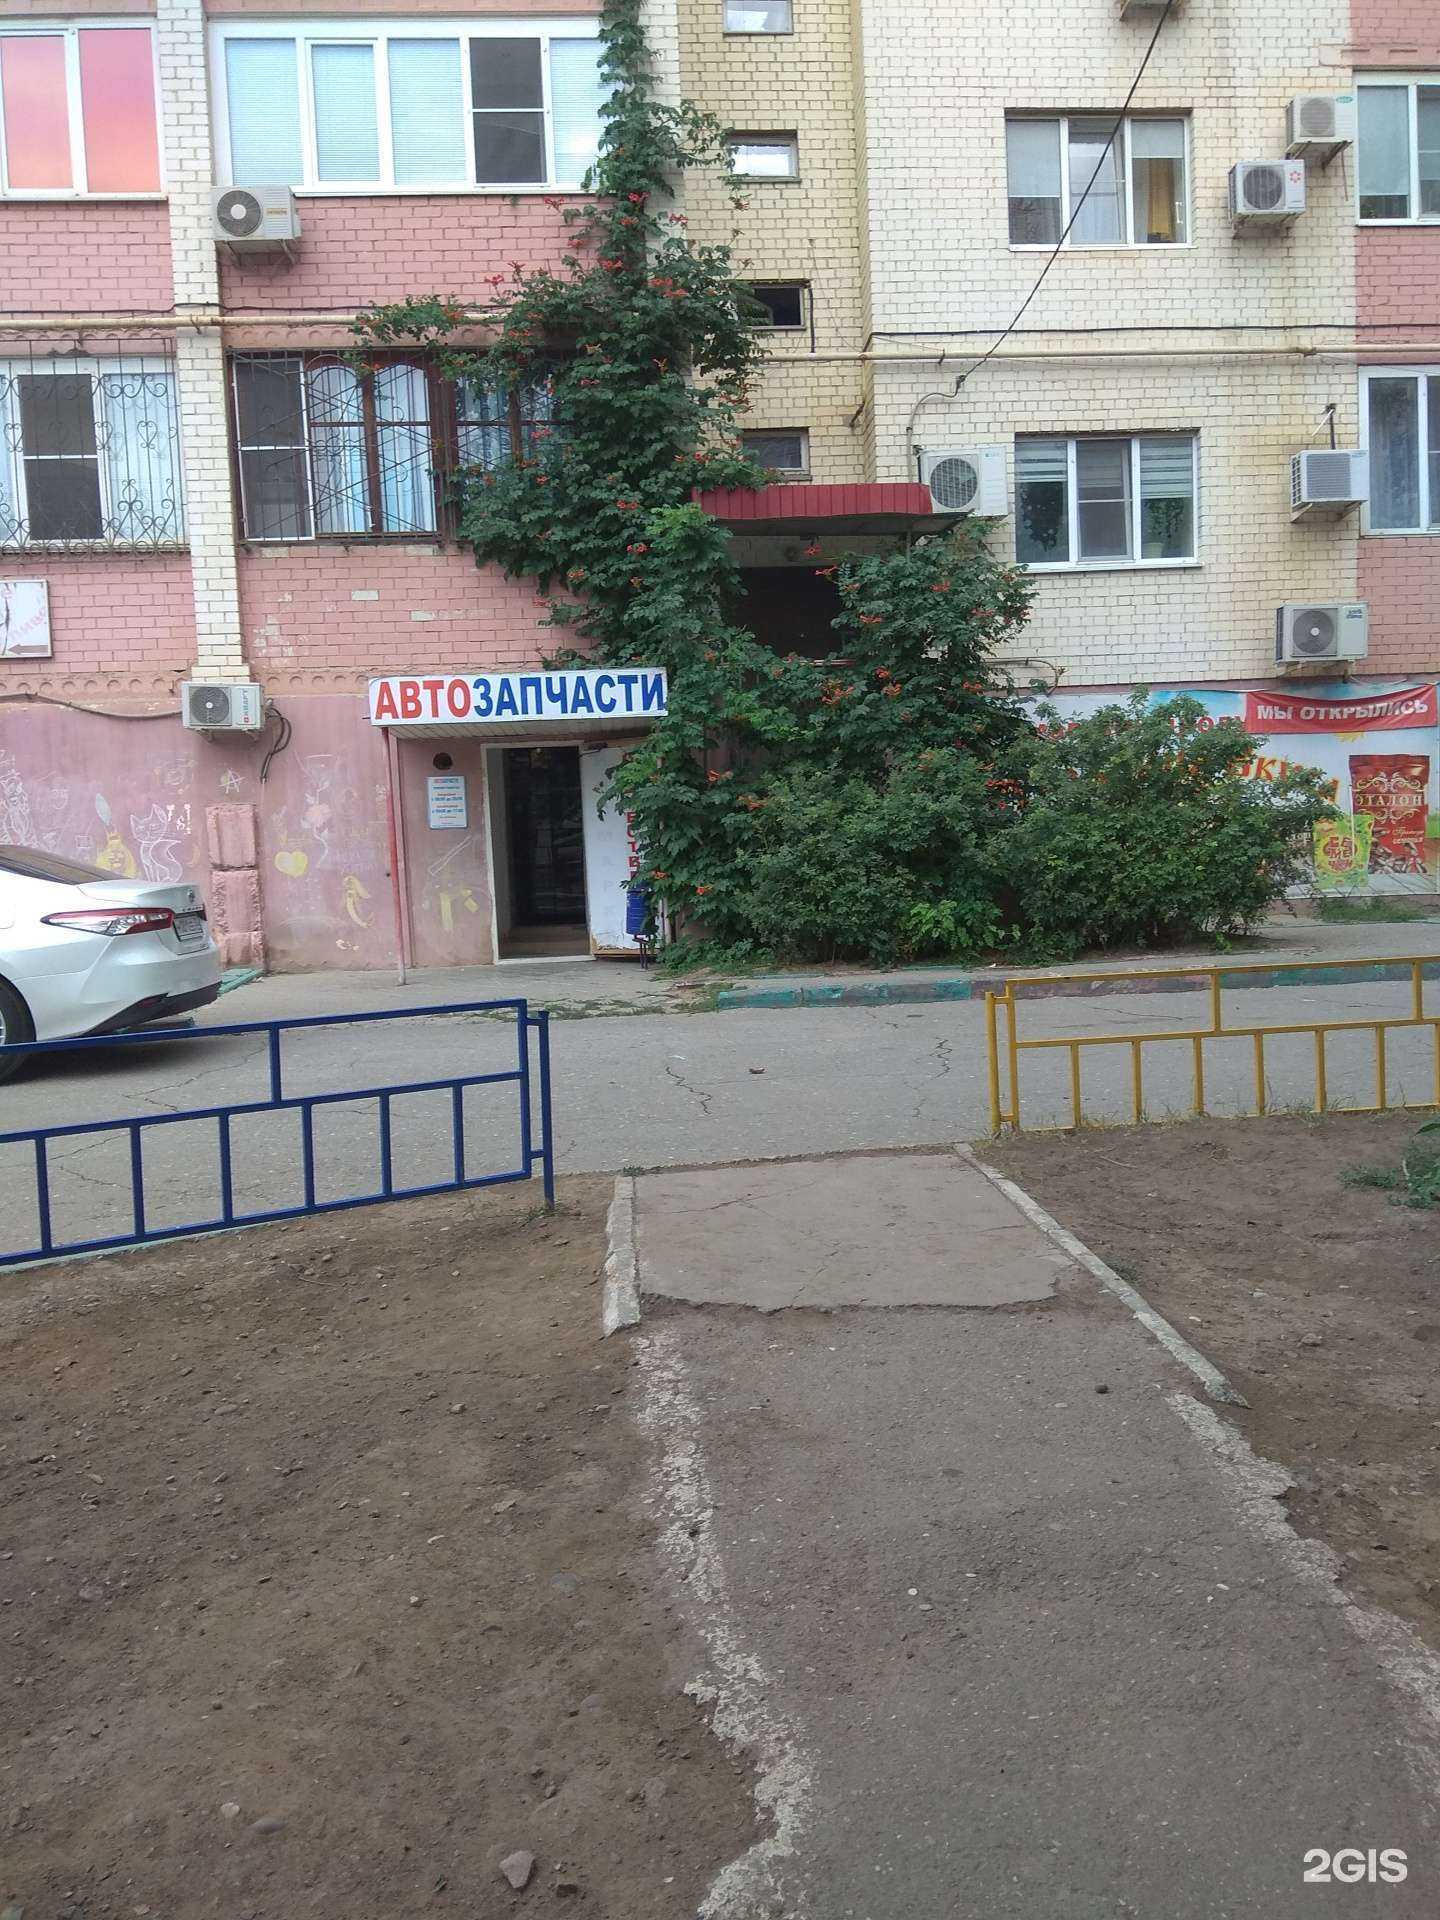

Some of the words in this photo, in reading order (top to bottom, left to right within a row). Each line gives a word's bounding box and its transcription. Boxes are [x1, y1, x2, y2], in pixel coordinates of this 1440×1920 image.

[375, 673, 667, 719] АВТОЗАПЧАСТИ
[1257, 705, 1292, 720] МЫ
[1300, 699, 1429, 720] ОТКРЫЛИСЬ
[1355, 795, 1423, 806] ЭТАЛОН
